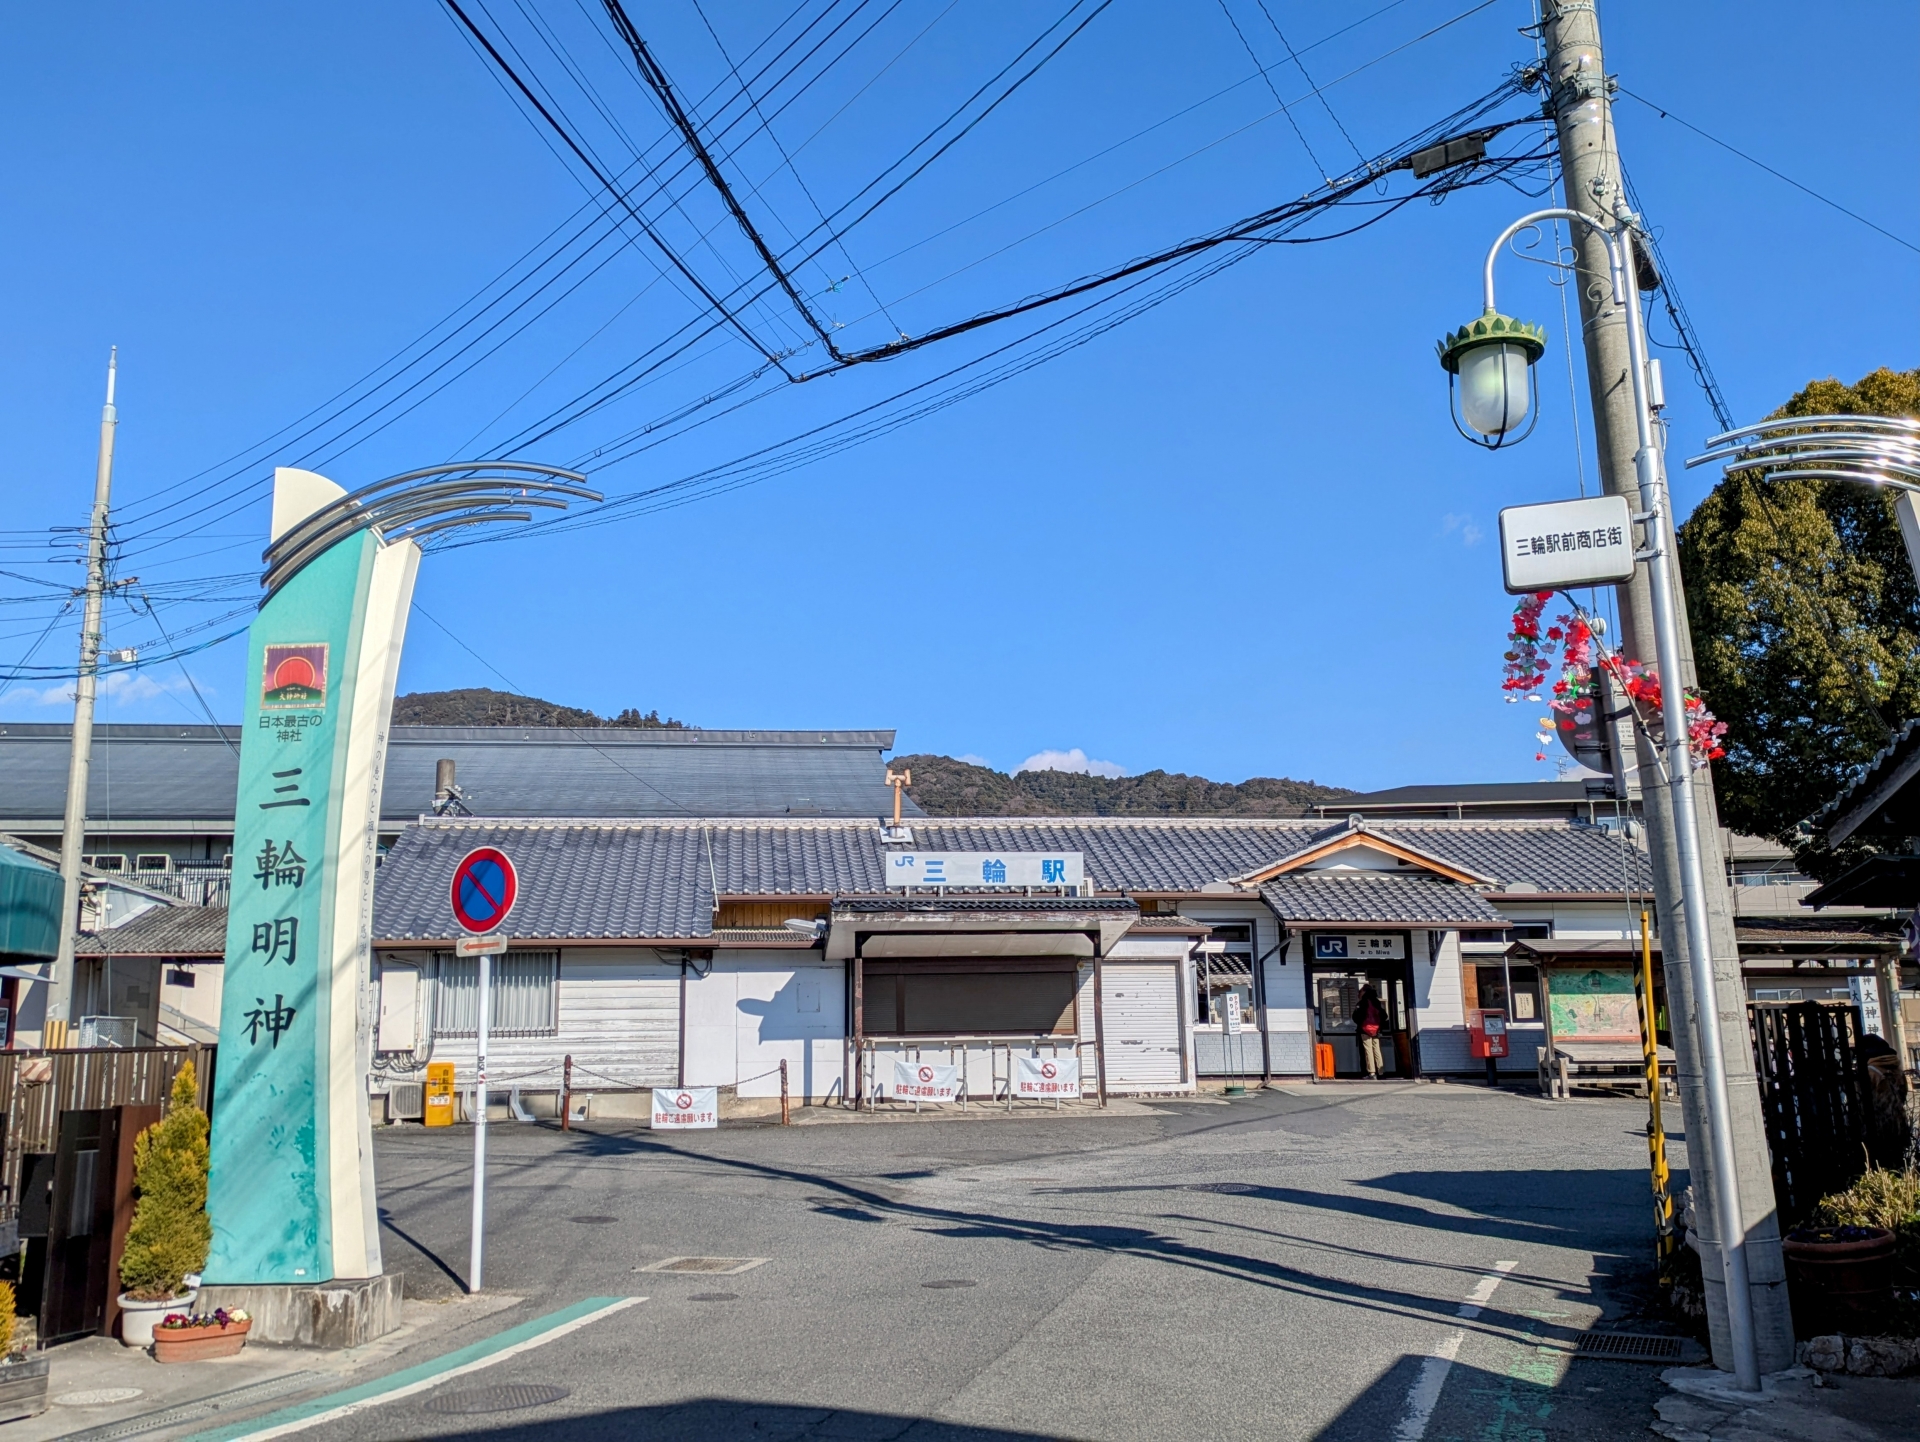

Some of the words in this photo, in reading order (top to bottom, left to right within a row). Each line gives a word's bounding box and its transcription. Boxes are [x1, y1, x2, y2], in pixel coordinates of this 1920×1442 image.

[1516, 526, 1623, 557] 三輪駅前商店街
[259, 715, 323, 729] 日本最古の
[276, 729, 303, 743] 神社
[895, 855, 915, 867] JR
[923, 858, 1066, 884] 三輪駅
[240, 768, 311, 1050] 三輪明神
[1321, 941, 1343, 953] JR
[1357, 938, 1392, 948] 三輪駅
